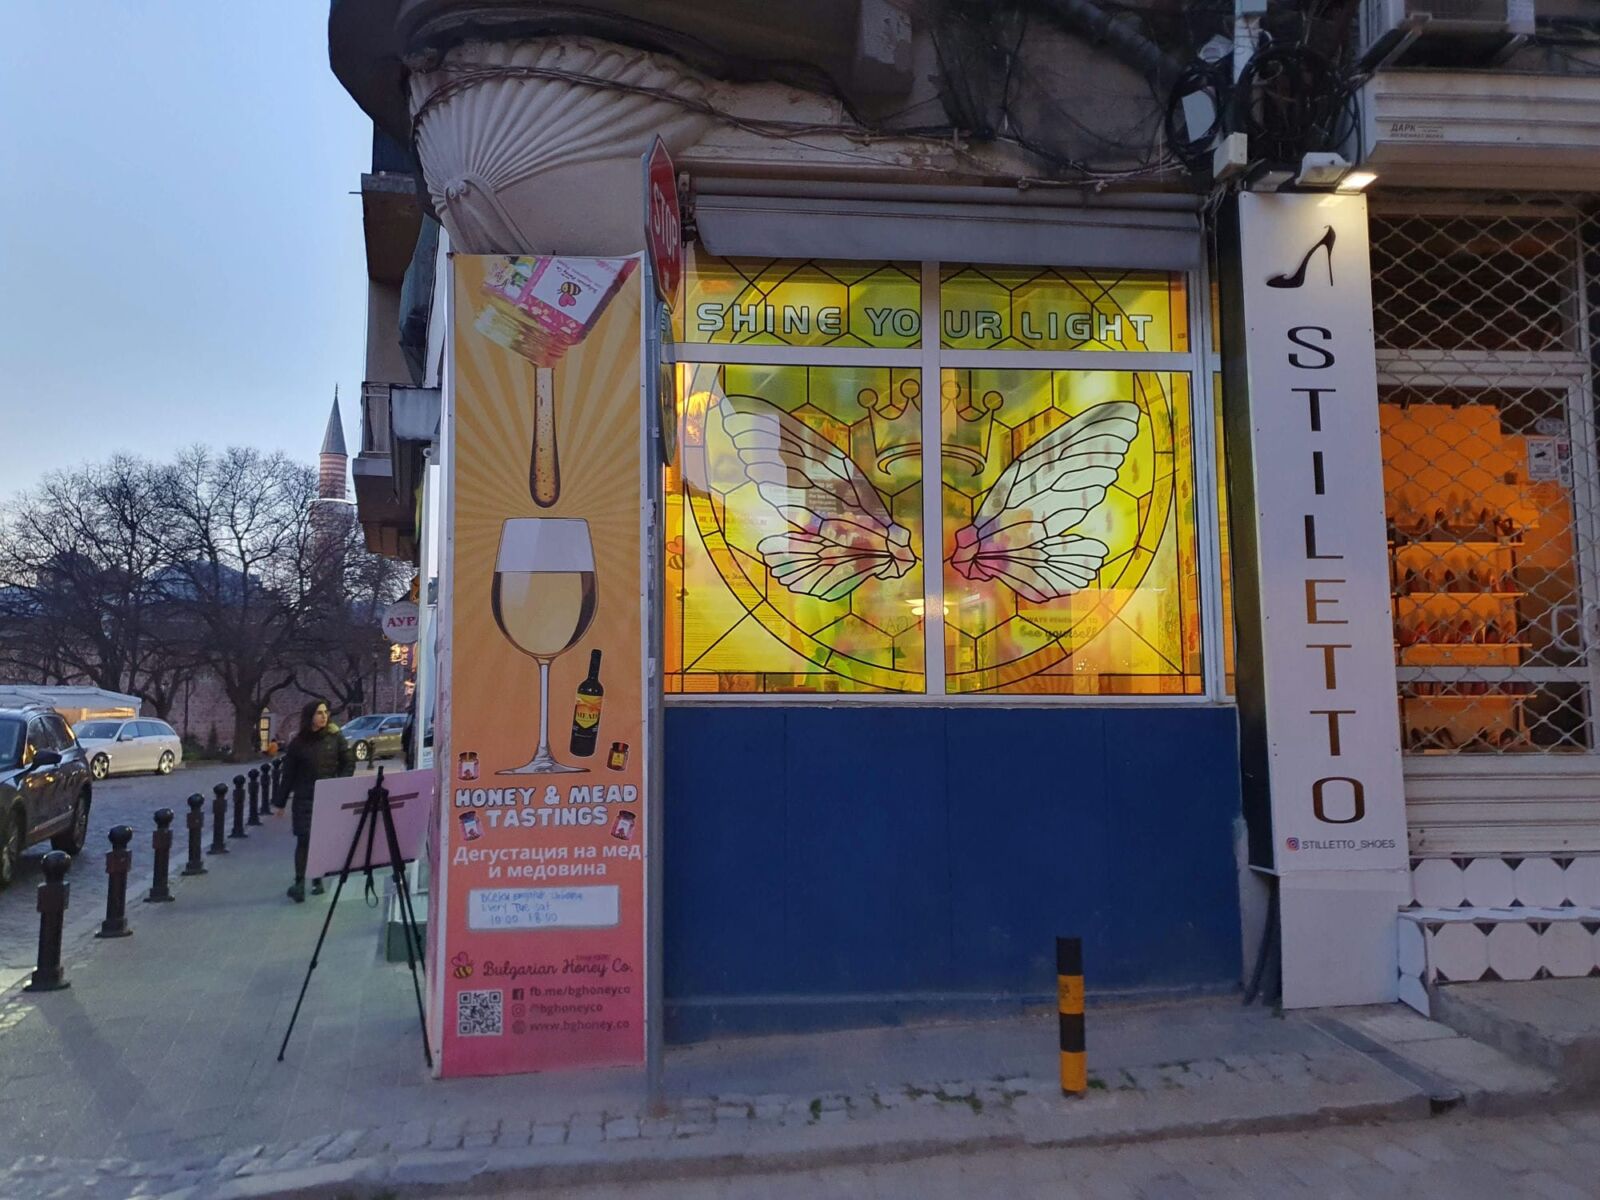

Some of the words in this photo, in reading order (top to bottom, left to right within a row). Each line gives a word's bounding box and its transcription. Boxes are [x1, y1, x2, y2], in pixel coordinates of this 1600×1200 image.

[653, 181, 678, 263] STOP
[697, 302, 841, 335] SHINE
[865, 306, 1002, 341] YOUR
[1021, 311, 1154, 342] LIGHT
[1287, 325, 1366, 825] STILETTO
[455, 786, 536, 808] HONEY
[543, 785, 561, 805] &
[569, 784, 639, 804] MEAD
[486, 806, 608, 829] TASTINGS
[453, 846, 568, 865] Дегустация
[574, 846, 597, 858] на
[602, 845, 642, 860] мед
[1301, 839, 1396, 852] STILLETTO_SHOES
[488, 866, 501, 879] и
[507, 863, 607, 879] медовина
[483, 961, 558, 980] Bulgarian
[563, 959, 608, 977] Honey
[529, 985, 631, 999] fb.me/bghoneyco
[529, 1020, 630, 1032] www.bghoney.co
